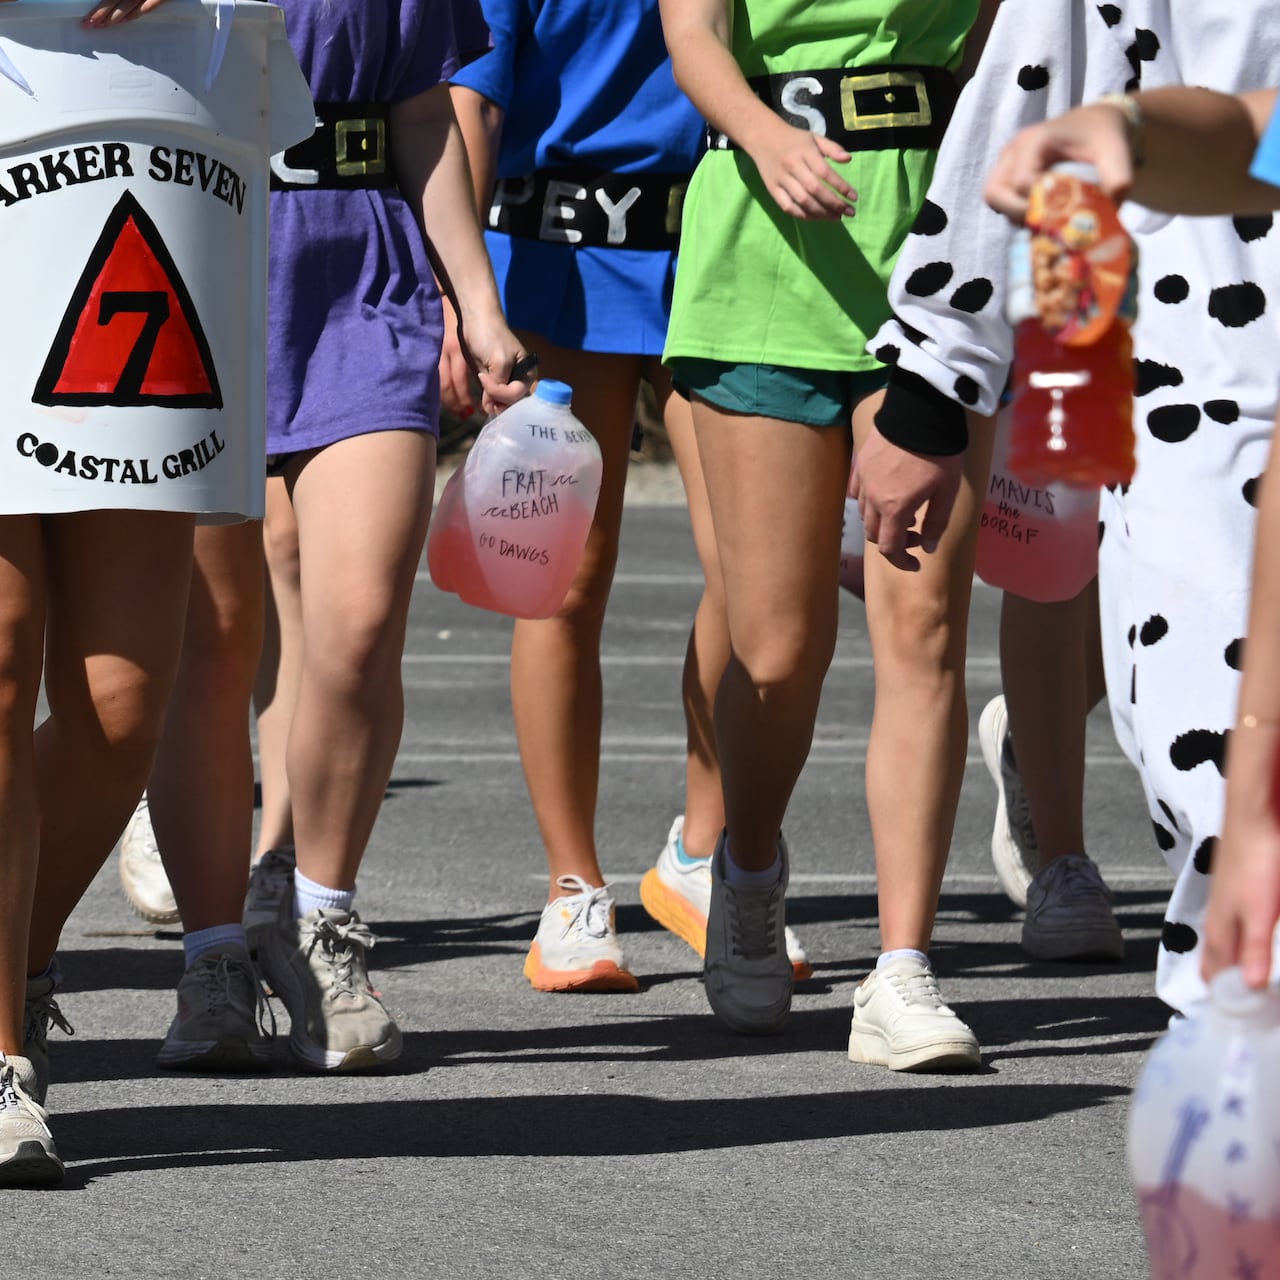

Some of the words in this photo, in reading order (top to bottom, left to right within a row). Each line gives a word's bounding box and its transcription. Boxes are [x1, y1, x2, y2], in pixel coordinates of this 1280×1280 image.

[148, 145, 247, 215] SEVEN
[96, 291, 171, 396] 7
[527, 424, 558, 442] THE
[16, 432, 158, 484] COASTAL
[162, 430, 226, 479] GRILL
[501, 469, 547, 498] FRAT
[989, 473, 1056, 516] MAVIS
[510, 493, 559, 520] BEACH
[996, 500, 1021, 519] the
[478, 532, 496, 548] GO
[499, 538, 550, 566] DAWGS
